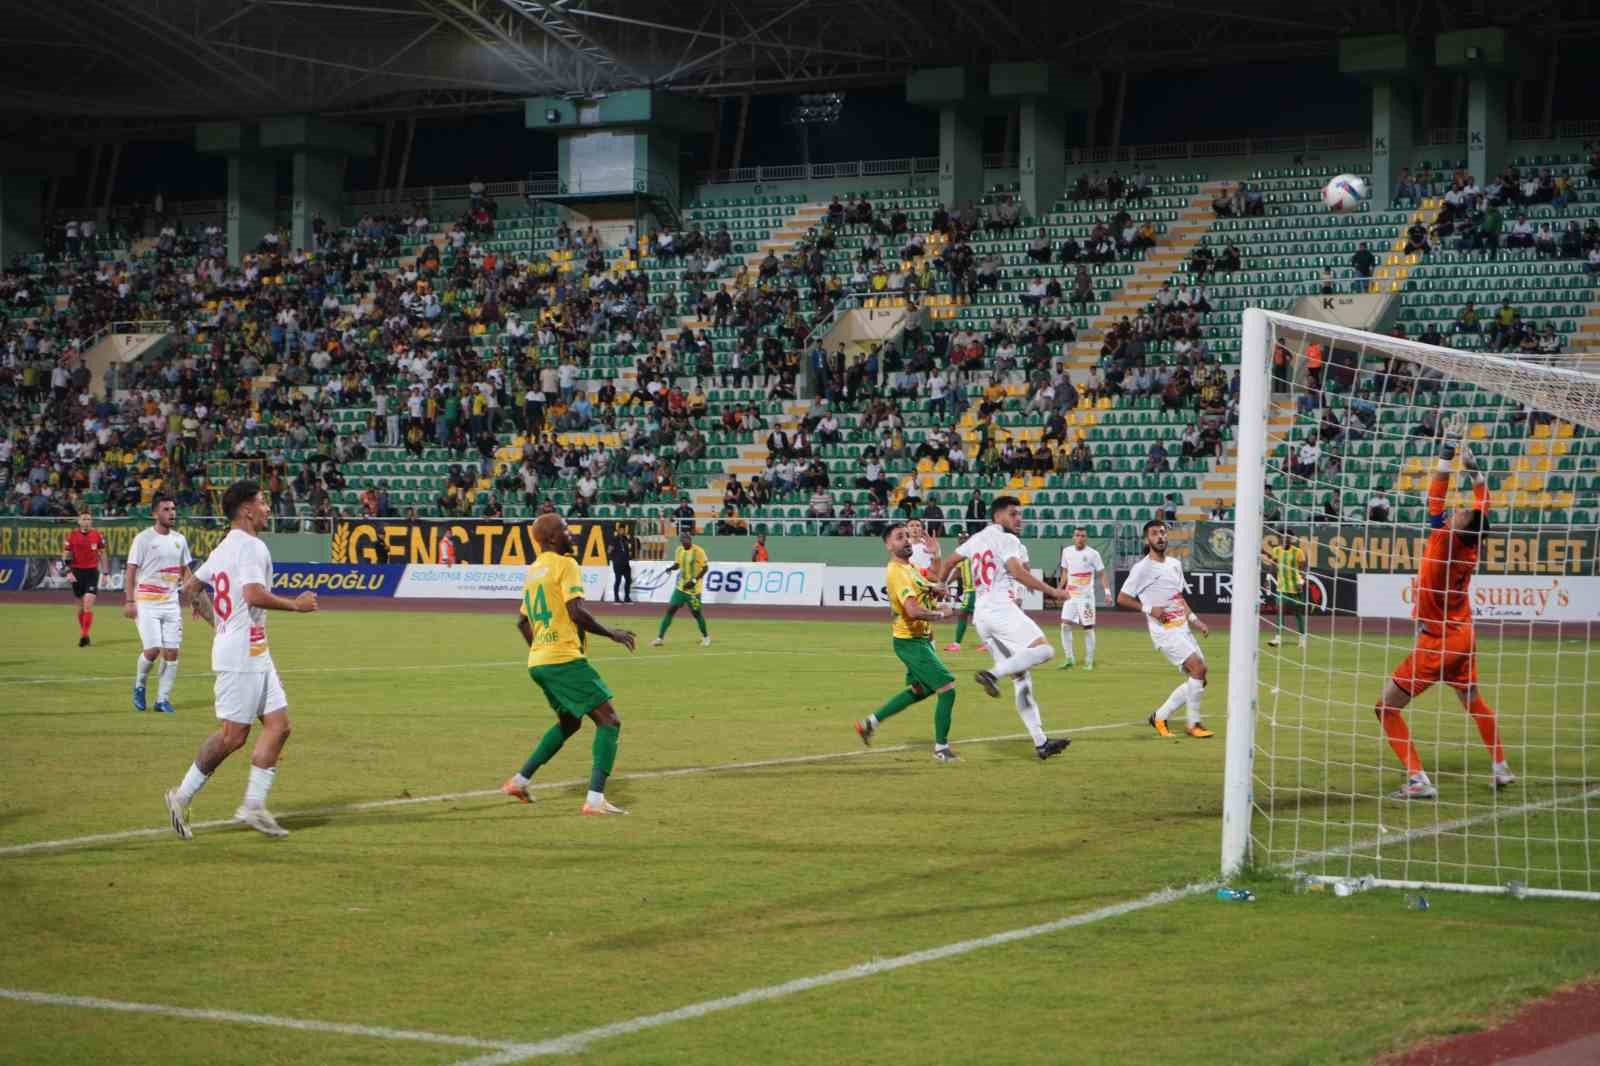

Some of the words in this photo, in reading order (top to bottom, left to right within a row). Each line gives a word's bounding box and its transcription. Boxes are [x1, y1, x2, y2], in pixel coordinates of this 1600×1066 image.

[1375, 137, 1387, 149] K
[1471, 131, 1482, 144] K
[1323, 298, 1335, 310] K
[972, 549, 997, 587] 26
[677, 570, 806, 600] espan
[1475, 579, 1569, 615] sunay's
[524, 583, 553, 629] 14
